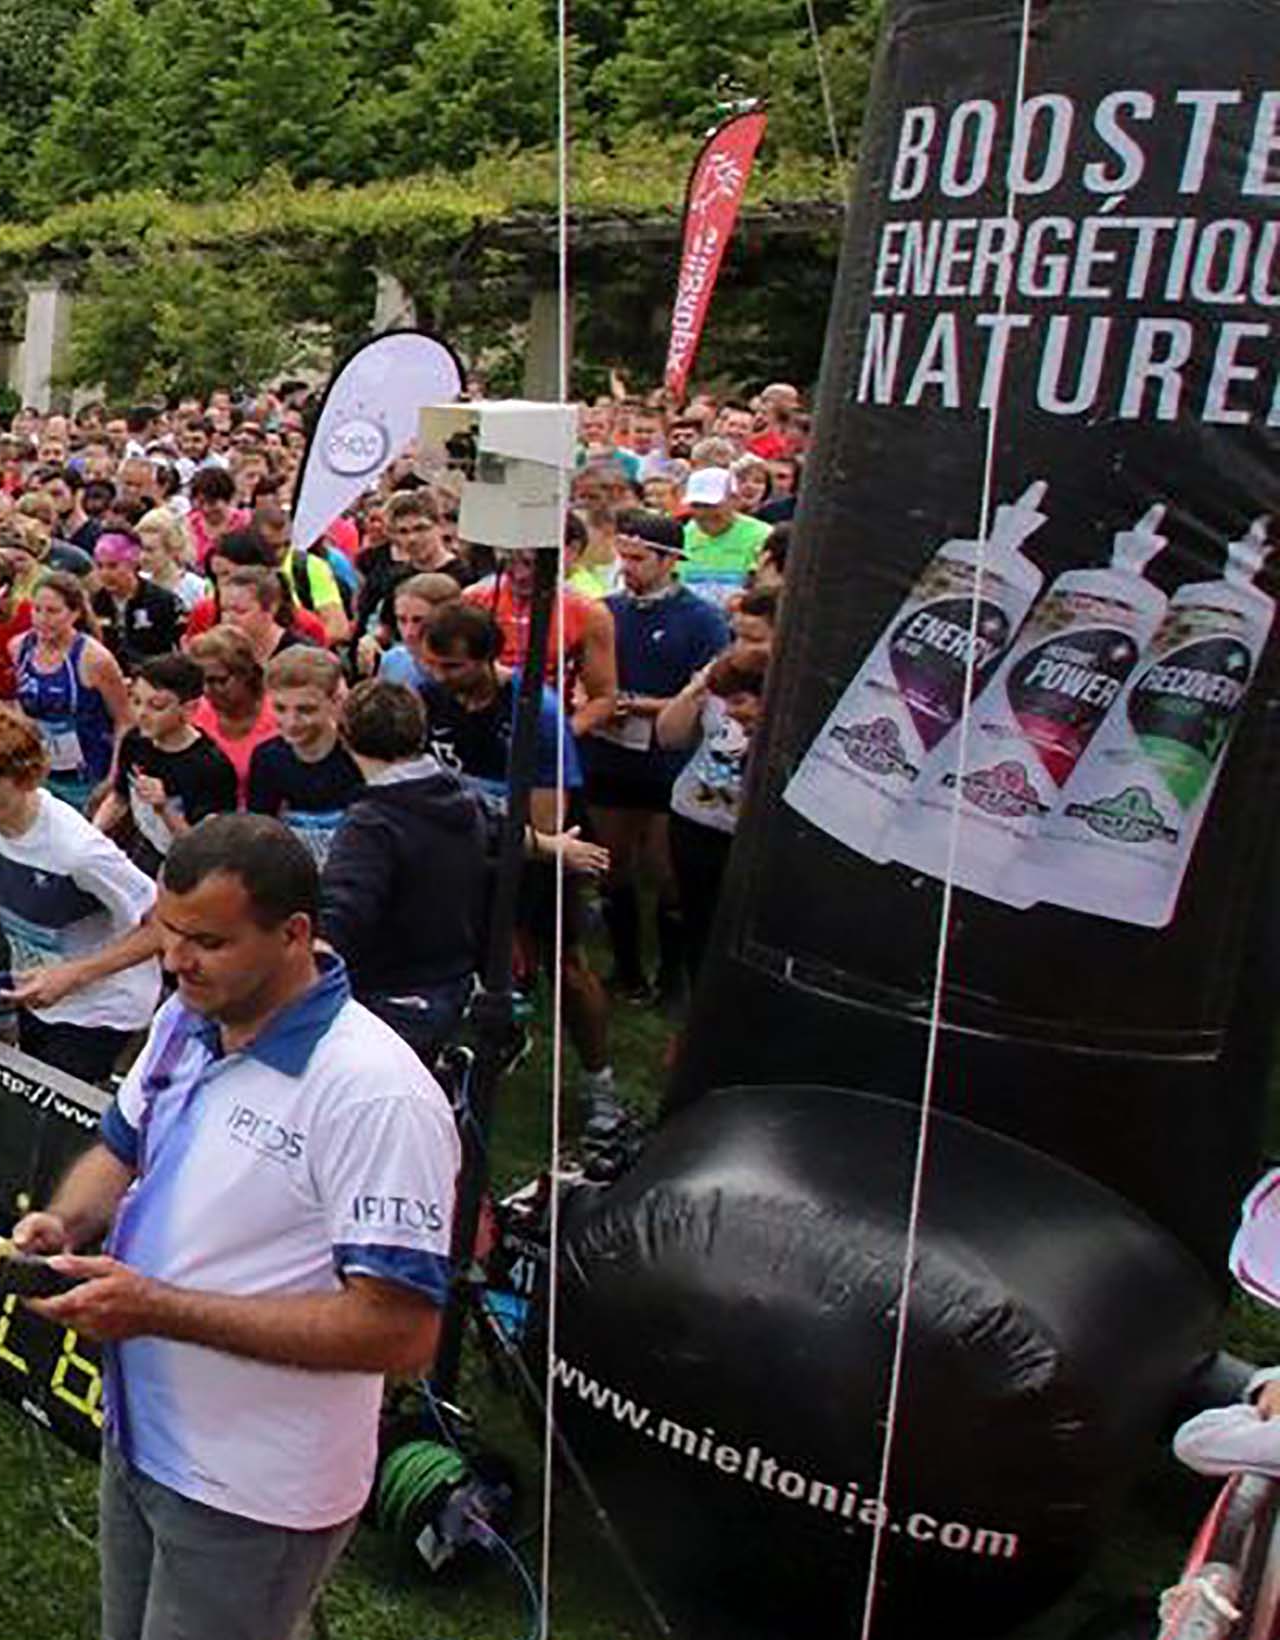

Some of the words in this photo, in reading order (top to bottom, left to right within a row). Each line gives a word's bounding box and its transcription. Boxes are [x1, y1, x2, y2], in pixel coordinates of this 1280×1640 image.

[857, 312, 1280, 427] NATURE
[1023, 658, 1122, 710] POWER
[1145, 664, 1243, 707] RECOVERY
[549, 1354, 1019, 1560] www.mieltonia.com
